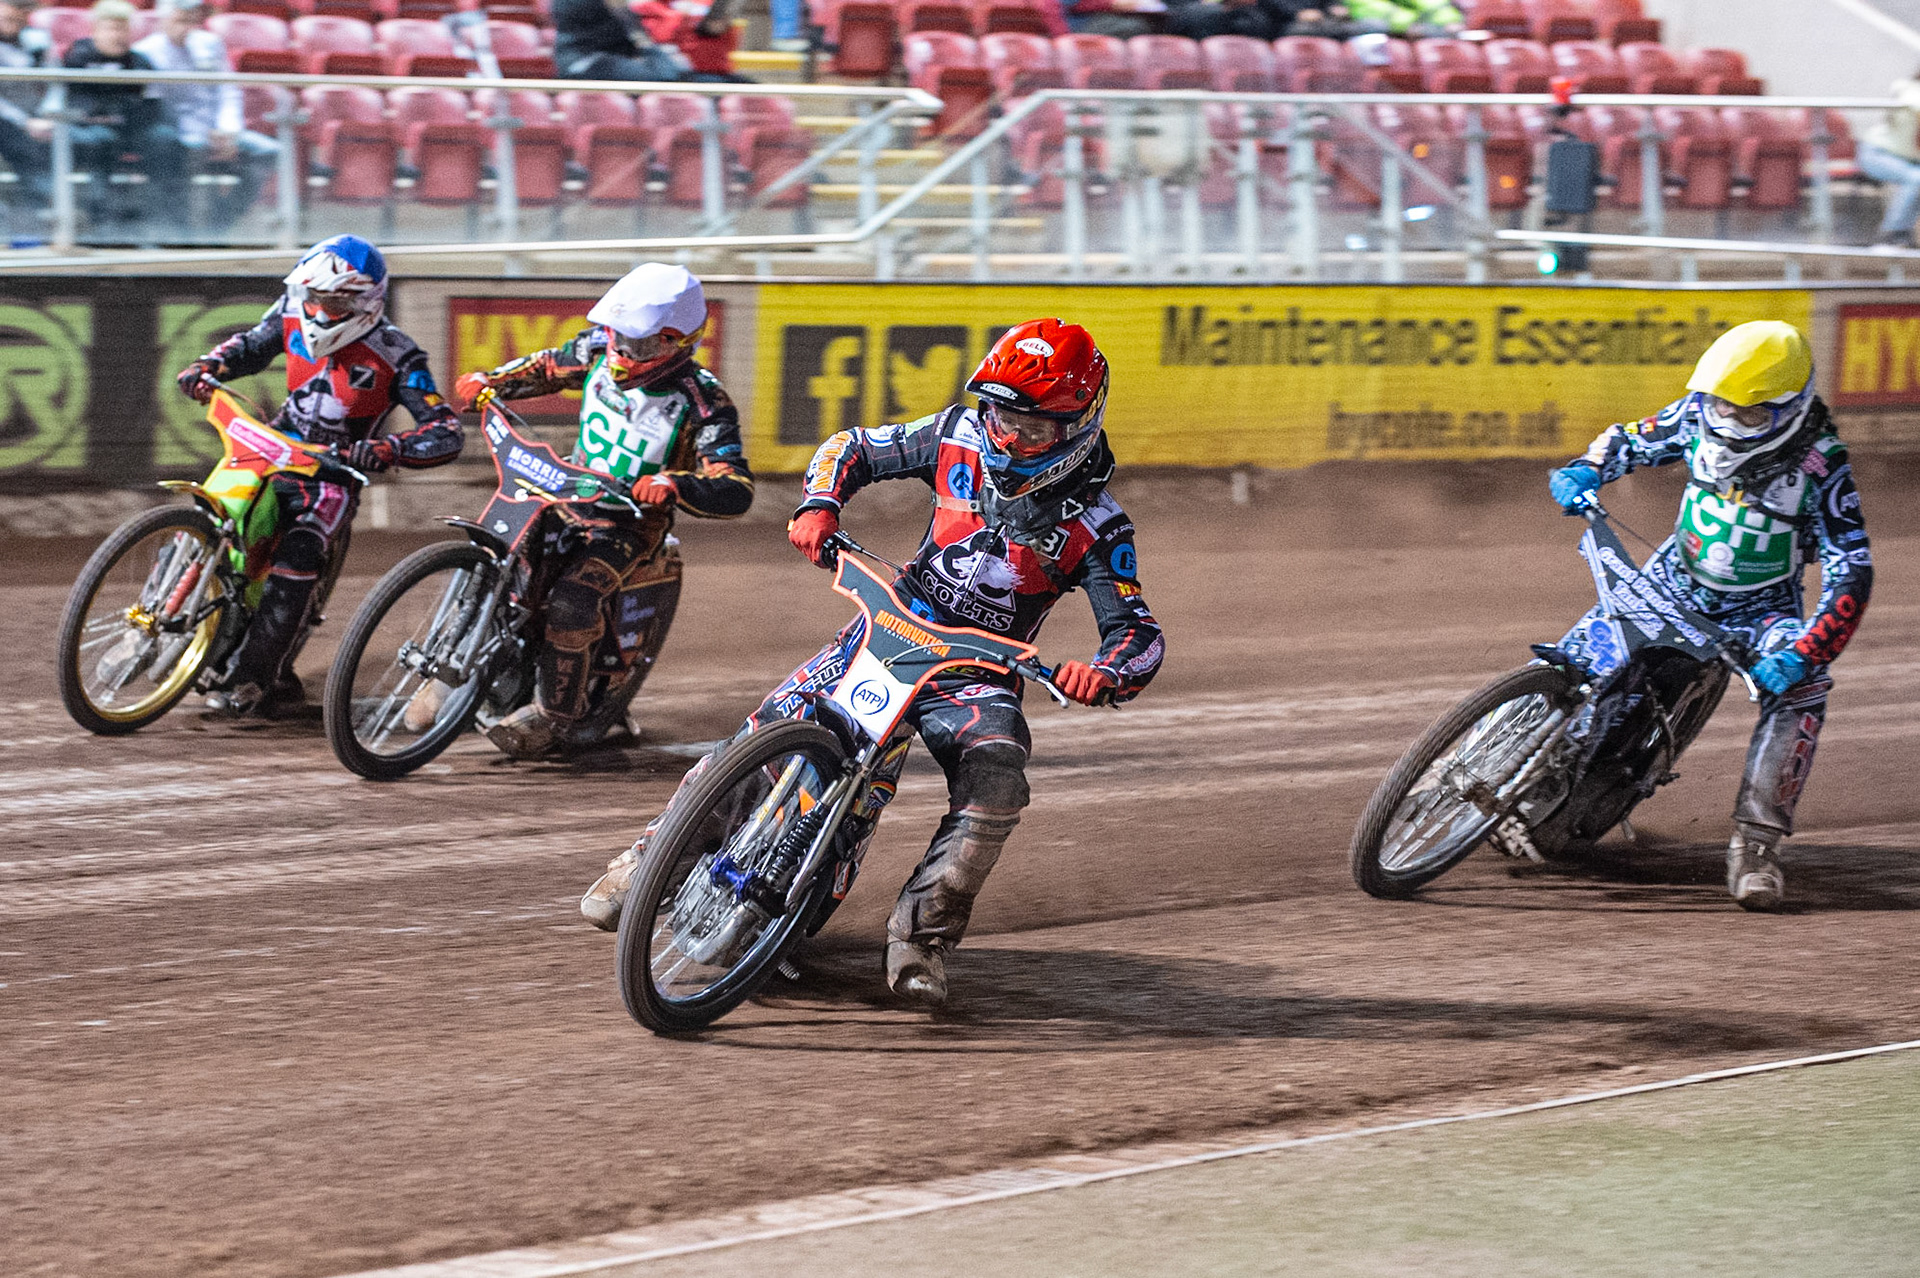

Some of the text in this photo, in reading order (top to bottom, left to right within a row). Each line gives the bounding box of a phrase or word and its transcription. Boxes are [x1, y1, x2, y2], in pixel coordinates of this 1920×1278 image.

[455, 314, 713, 399] HYC
[1022, 341, 1045, 353] BELL
[1161, 305, 1477, 366] Maintenance
[1841, 317, 1920, 392] HY
[508, 446, 568, 486] MORRIS
[1042, 532, 1059, 552] 3
[921, 570, 1014, 631] COLTS
[874, 609, 952, 658] MOTORVATION
[883, 627, 915, 649] TRAINING
[856, 688, 885, 708] ATPI
